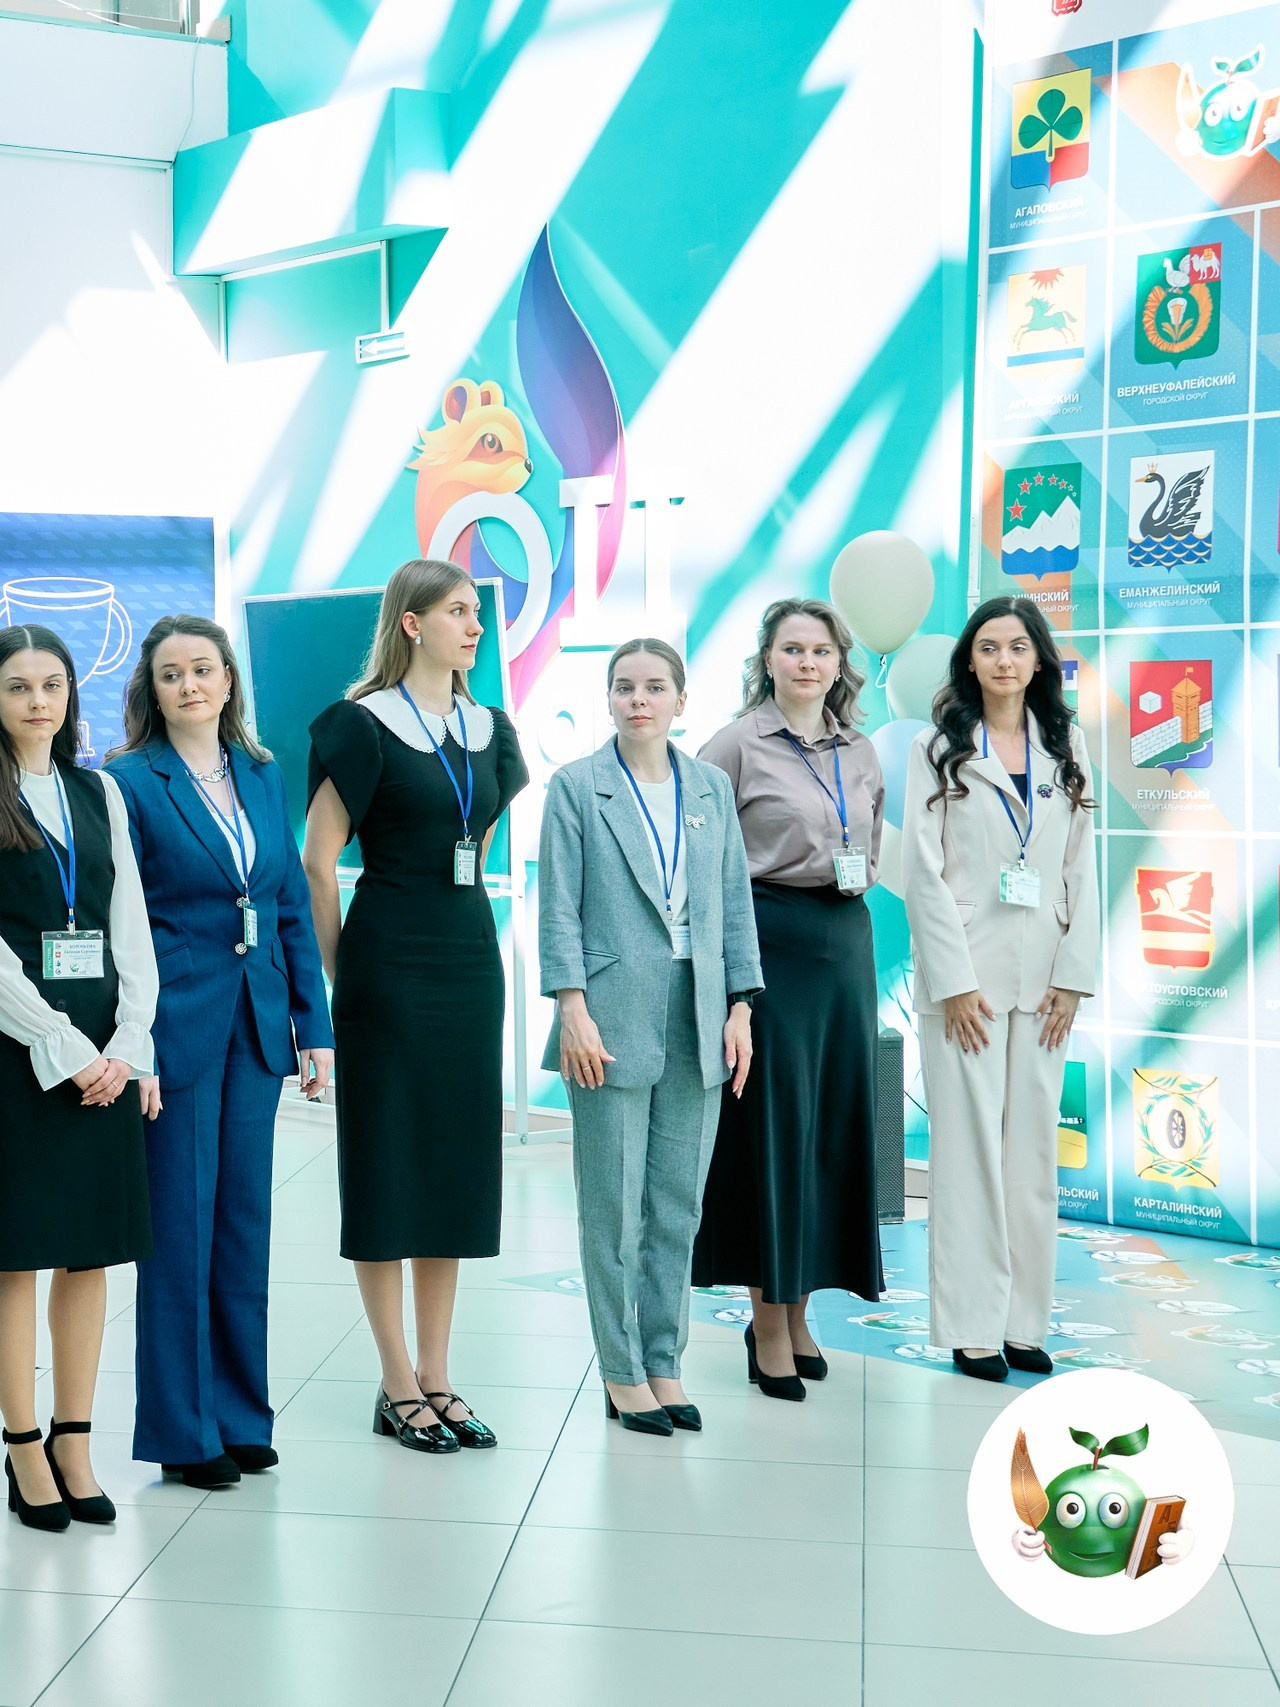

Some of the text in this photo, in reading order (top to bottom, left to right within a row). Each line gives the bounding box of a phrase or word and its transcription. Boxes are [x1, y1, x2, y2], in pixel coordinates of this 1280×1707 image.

[1117, 372, 1236, 397] ВЕРХНЕУФАЛЕЙСКИЙ
[1143, 392, 1208, 405] ГОРОДСКОЙ ОКРУГ
[1119, 580, 1220, 598] ЕМАНЖЕЛИНСКИЙ
[1127, 597, 1212, 608] МУНИЦИПАЛЬНЫЙ ОКРУГ
[1137, 787, 1210, 800] ЕТКУЛЬСКИЙ
[1186, 999, 1209, 1008] ОКРУГ
[1134, 1196, 1222, 1219] КАРТАЛИНСКИЙ
[1136, 1210, 1221, 1229] МУНИЦИПАЛЬНЫЙ ОКРУГ
